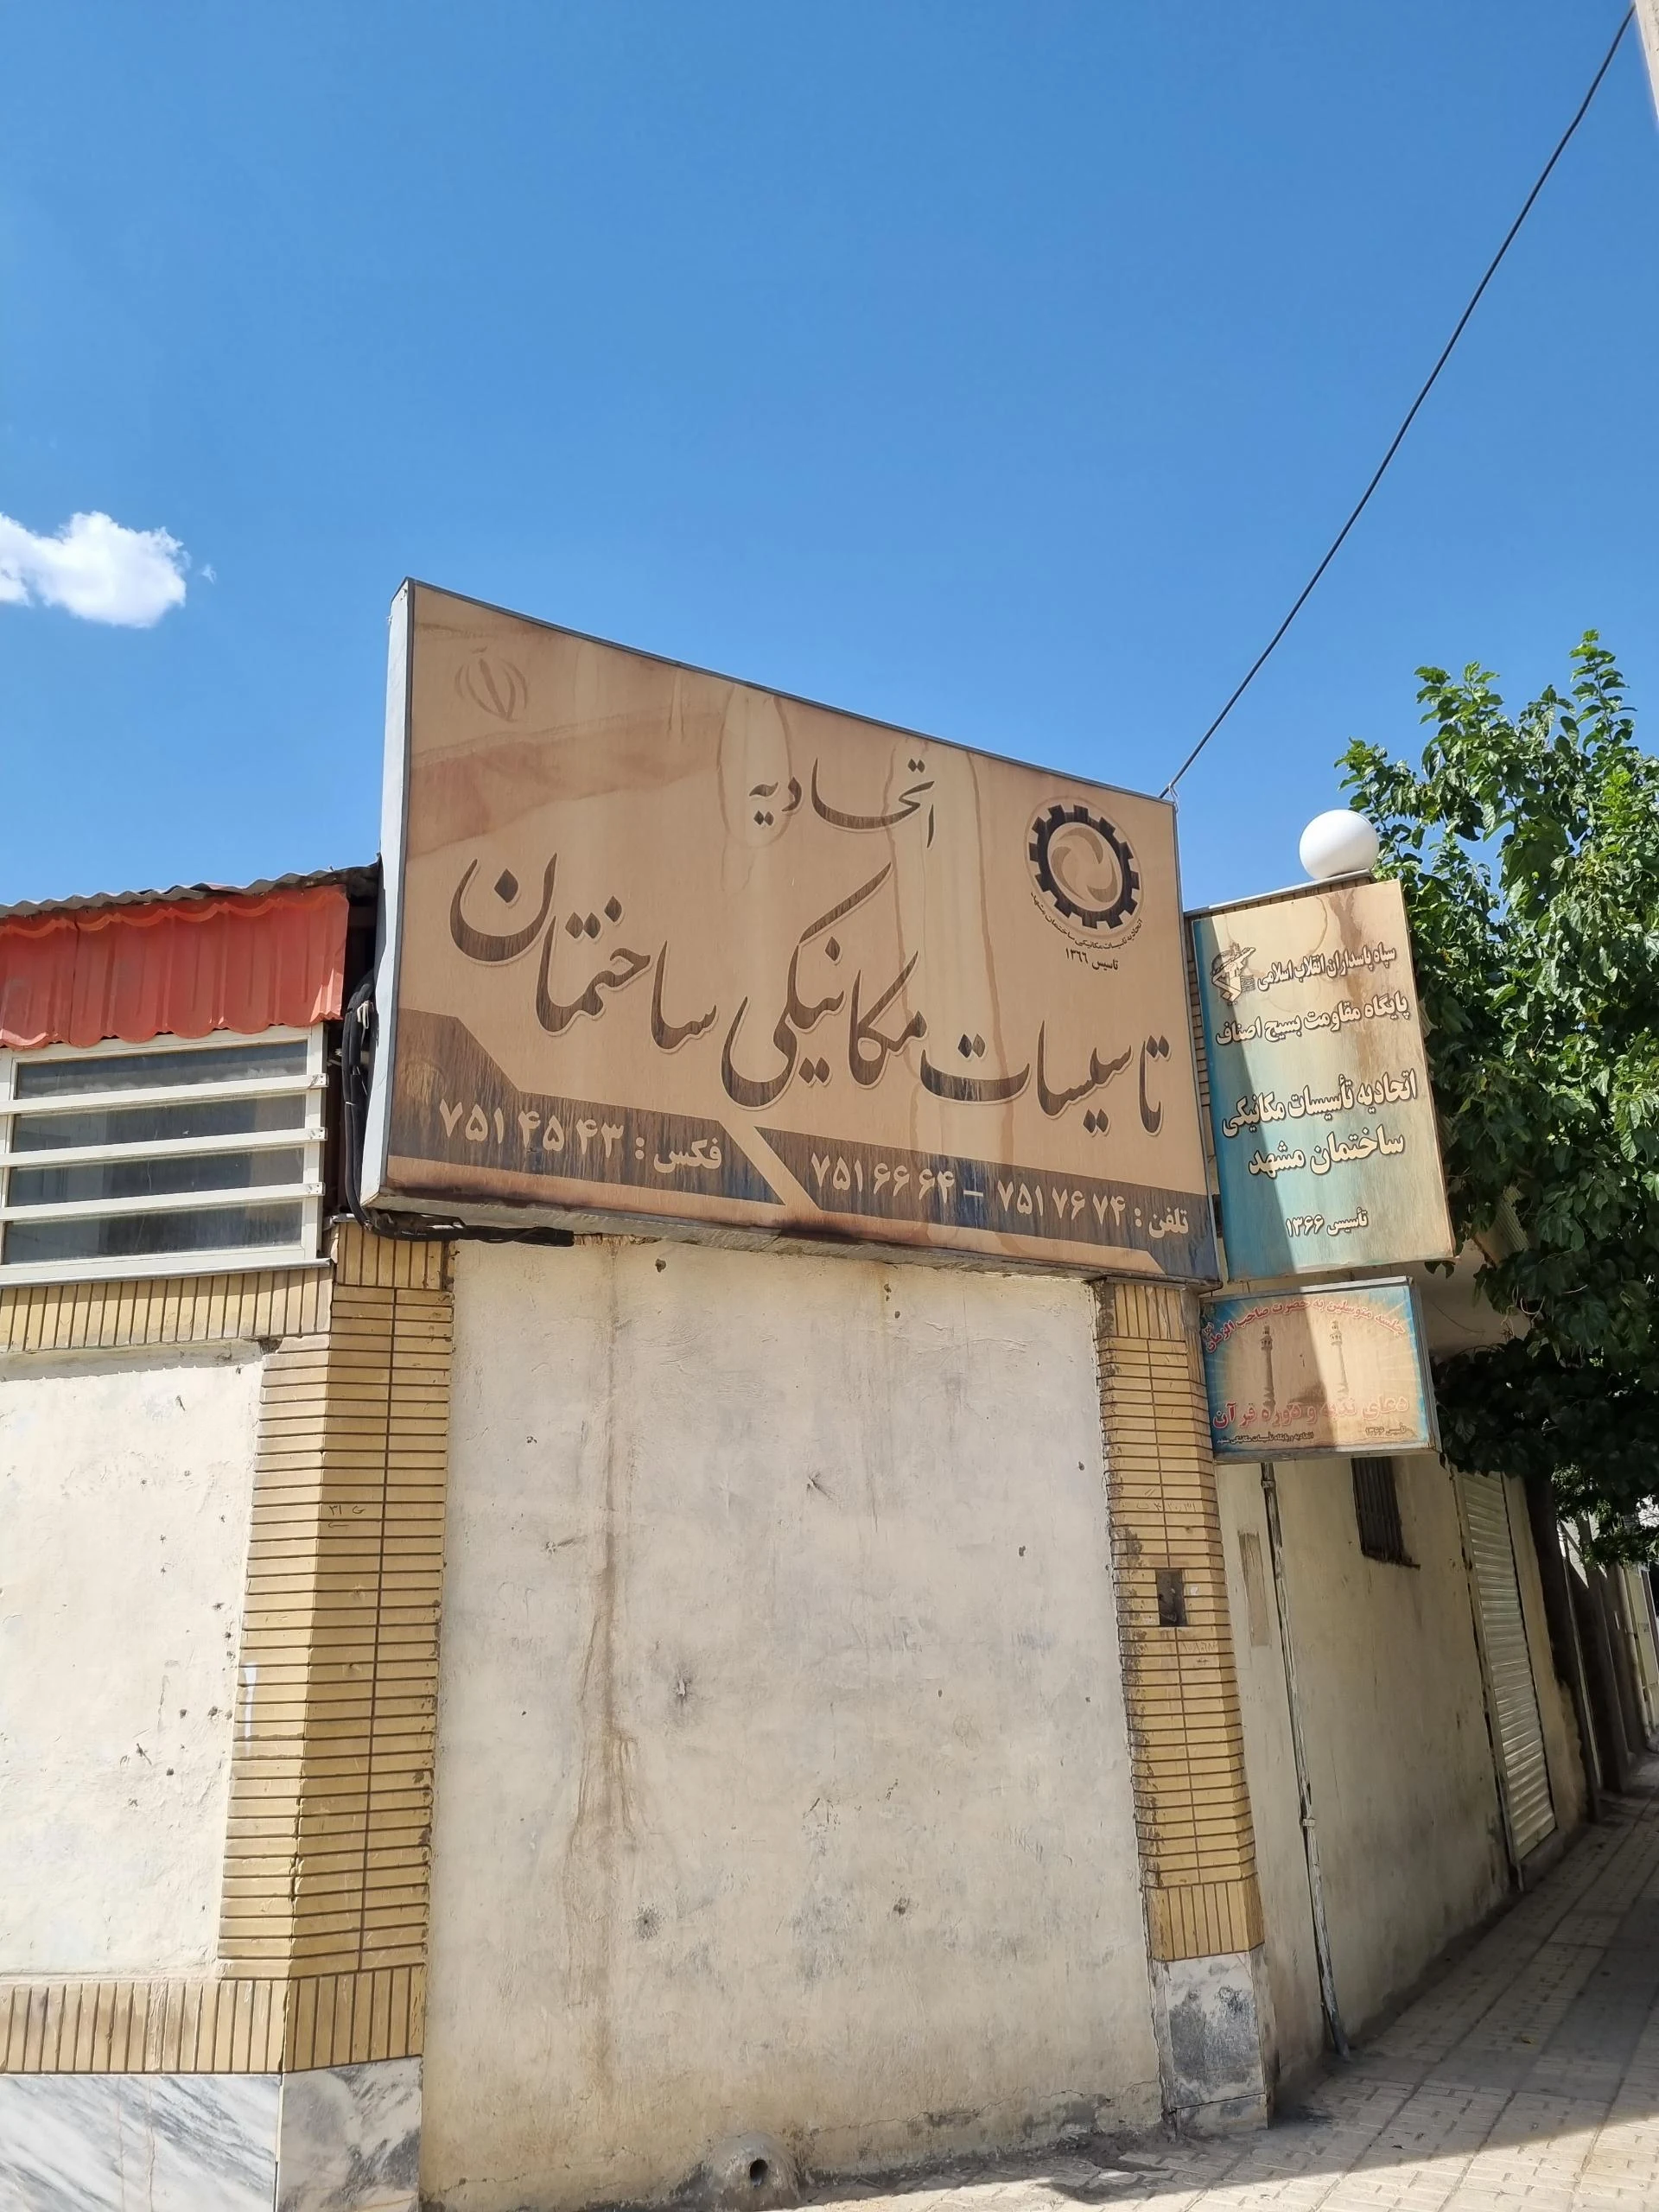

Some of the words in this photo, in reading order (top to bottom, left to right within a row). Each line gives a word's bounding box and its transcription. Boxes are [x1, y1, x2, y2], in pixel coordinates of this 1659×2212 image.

[748, 757, 936, 849] اتحادیه
[1045, 914, 1076, 941] ساختمان
[449, 851, 717, 1054] ساختمان
[1326, 945, 1374, 978] پاسداران
[1372, 942, 1396, 969] سپاه
[1257, 960, 1294, 992] اسلامی
[1294, 953, 1326, 982] انقلاب
[721, 861, 928, 1110] مکانیکی
[1304, 1001, 1362, 1033] مقاومت
[1363, 991, 1410, 1020] پایگاه
[1216, 1015, 1262, 1046] اصناف
[1264, 1015, 1302, 1042] بسیج
[920, 1020, 1171, 1136] تاسیسات
[1357, 1068, 1418, 1115] اتحادیه
[1288, 1074, 1355, 1121] تأسیسات
[1222, 1091, 1287, 1138] مکانیکی
[1249, 1141, 1306, 1180] مشهد
[1310, 1123, 1405, 1175] ساختمان
[1286, 1214, 1325, 1237] ۱۳۶۶
[1327, 1206, 1369, 1236] تأسیس
[1236, 1306, 1270, 1329] صاحب
[1271, 1299, 1310, 1314] حضرت
[1313, 1299, 1325, 1312] به
[1326, 1299, 1373, 1319] متوسلین
[1206, 1319, 1236, 1353] الزمان
[1374, 1314, 1406, 1336] جلسه
[1262, 1402, 1302, 1427] دوره
[1306, 1404, 1318, 1424] و
[1320, 1396, 1357, 1421] ندبه
[1362, 1394, 1410, 1421] دعای
